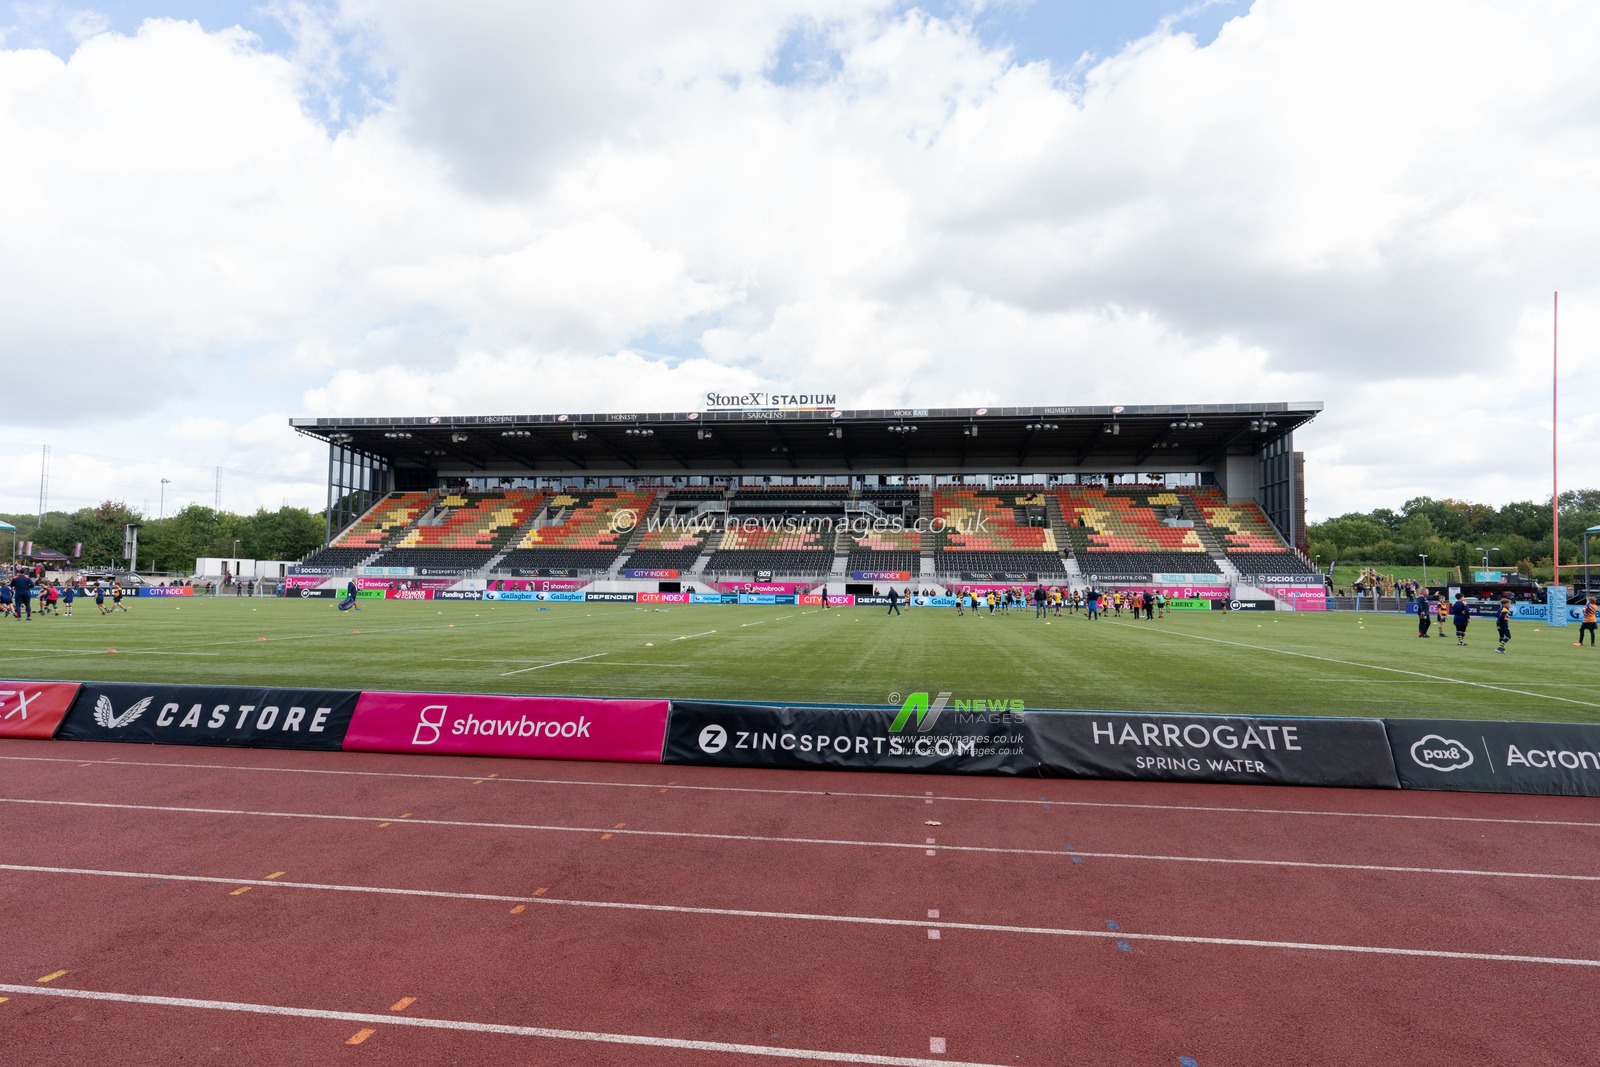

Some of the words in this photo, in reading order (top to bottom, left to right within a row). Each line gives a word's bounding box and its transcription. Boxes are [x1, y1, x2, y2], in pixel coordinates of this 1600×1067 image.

[706, 392, 763, 406] StoneX
[771, 394, 836, 405] STADIUM
[501, 592, 532, 601] Gallagher
[551, 593, 583, 601] Gallagher
[642, 594, 660, 602] CITY
[661, 594, 684, 602] INDEX
[156, 702, 332, 732] CASTORE
[451, 713, 592, 738] shawbrook
[735, 731, 976, 757] ZINCSPORTS.COM
[1092, 721, 1302, 750] HARROGATE
[1135, 756, 1201, 771] SPRING
[1206, 759, 1267, 773] WATER
[1423, 747, 1460, 761] pax8
[1506, 744, 1600, 770] Acron
